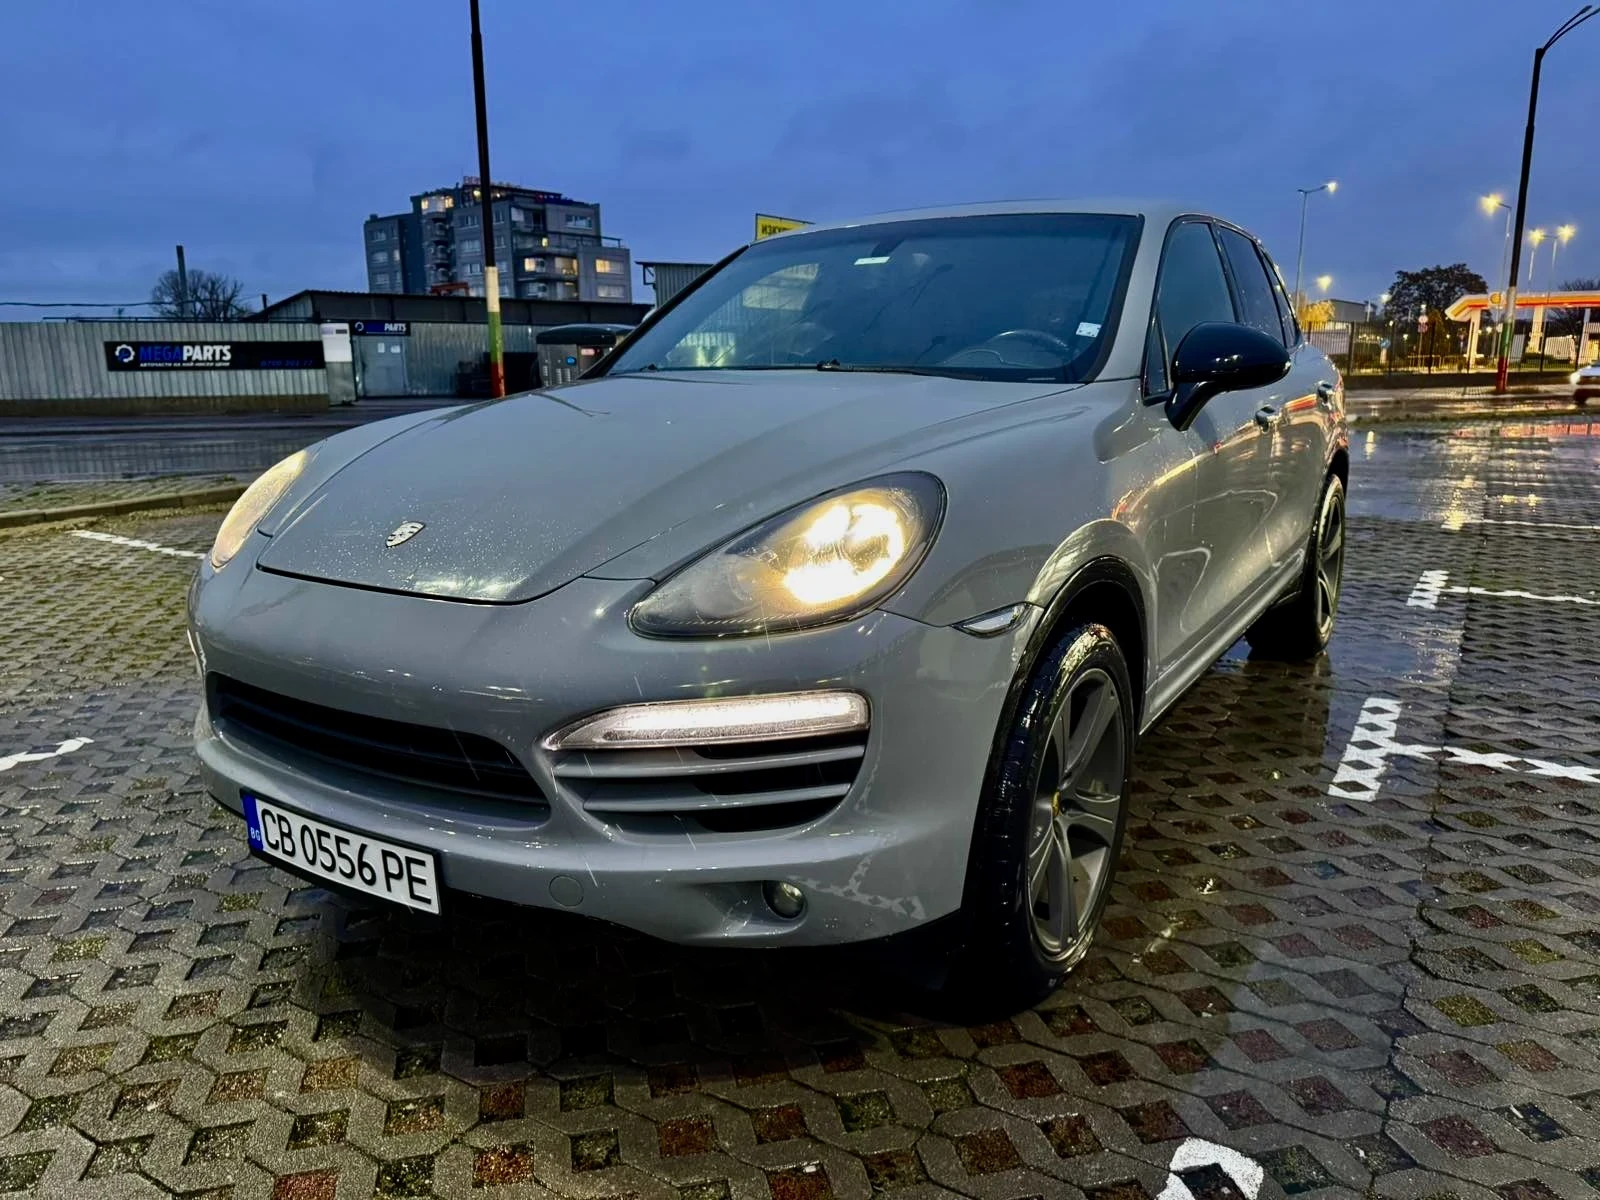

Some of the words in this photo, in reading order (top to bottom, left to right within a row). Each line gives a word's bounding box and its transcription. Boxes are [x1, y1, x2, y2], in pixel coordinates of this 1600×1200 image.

[140, 345, 231, 361] MEGAPARTS
[250, 826, 261, 841] BG
[261, 808, 296, 858] CB
[300, 824, 377, 887] 0556
[381, 849, 432, 905] PE
